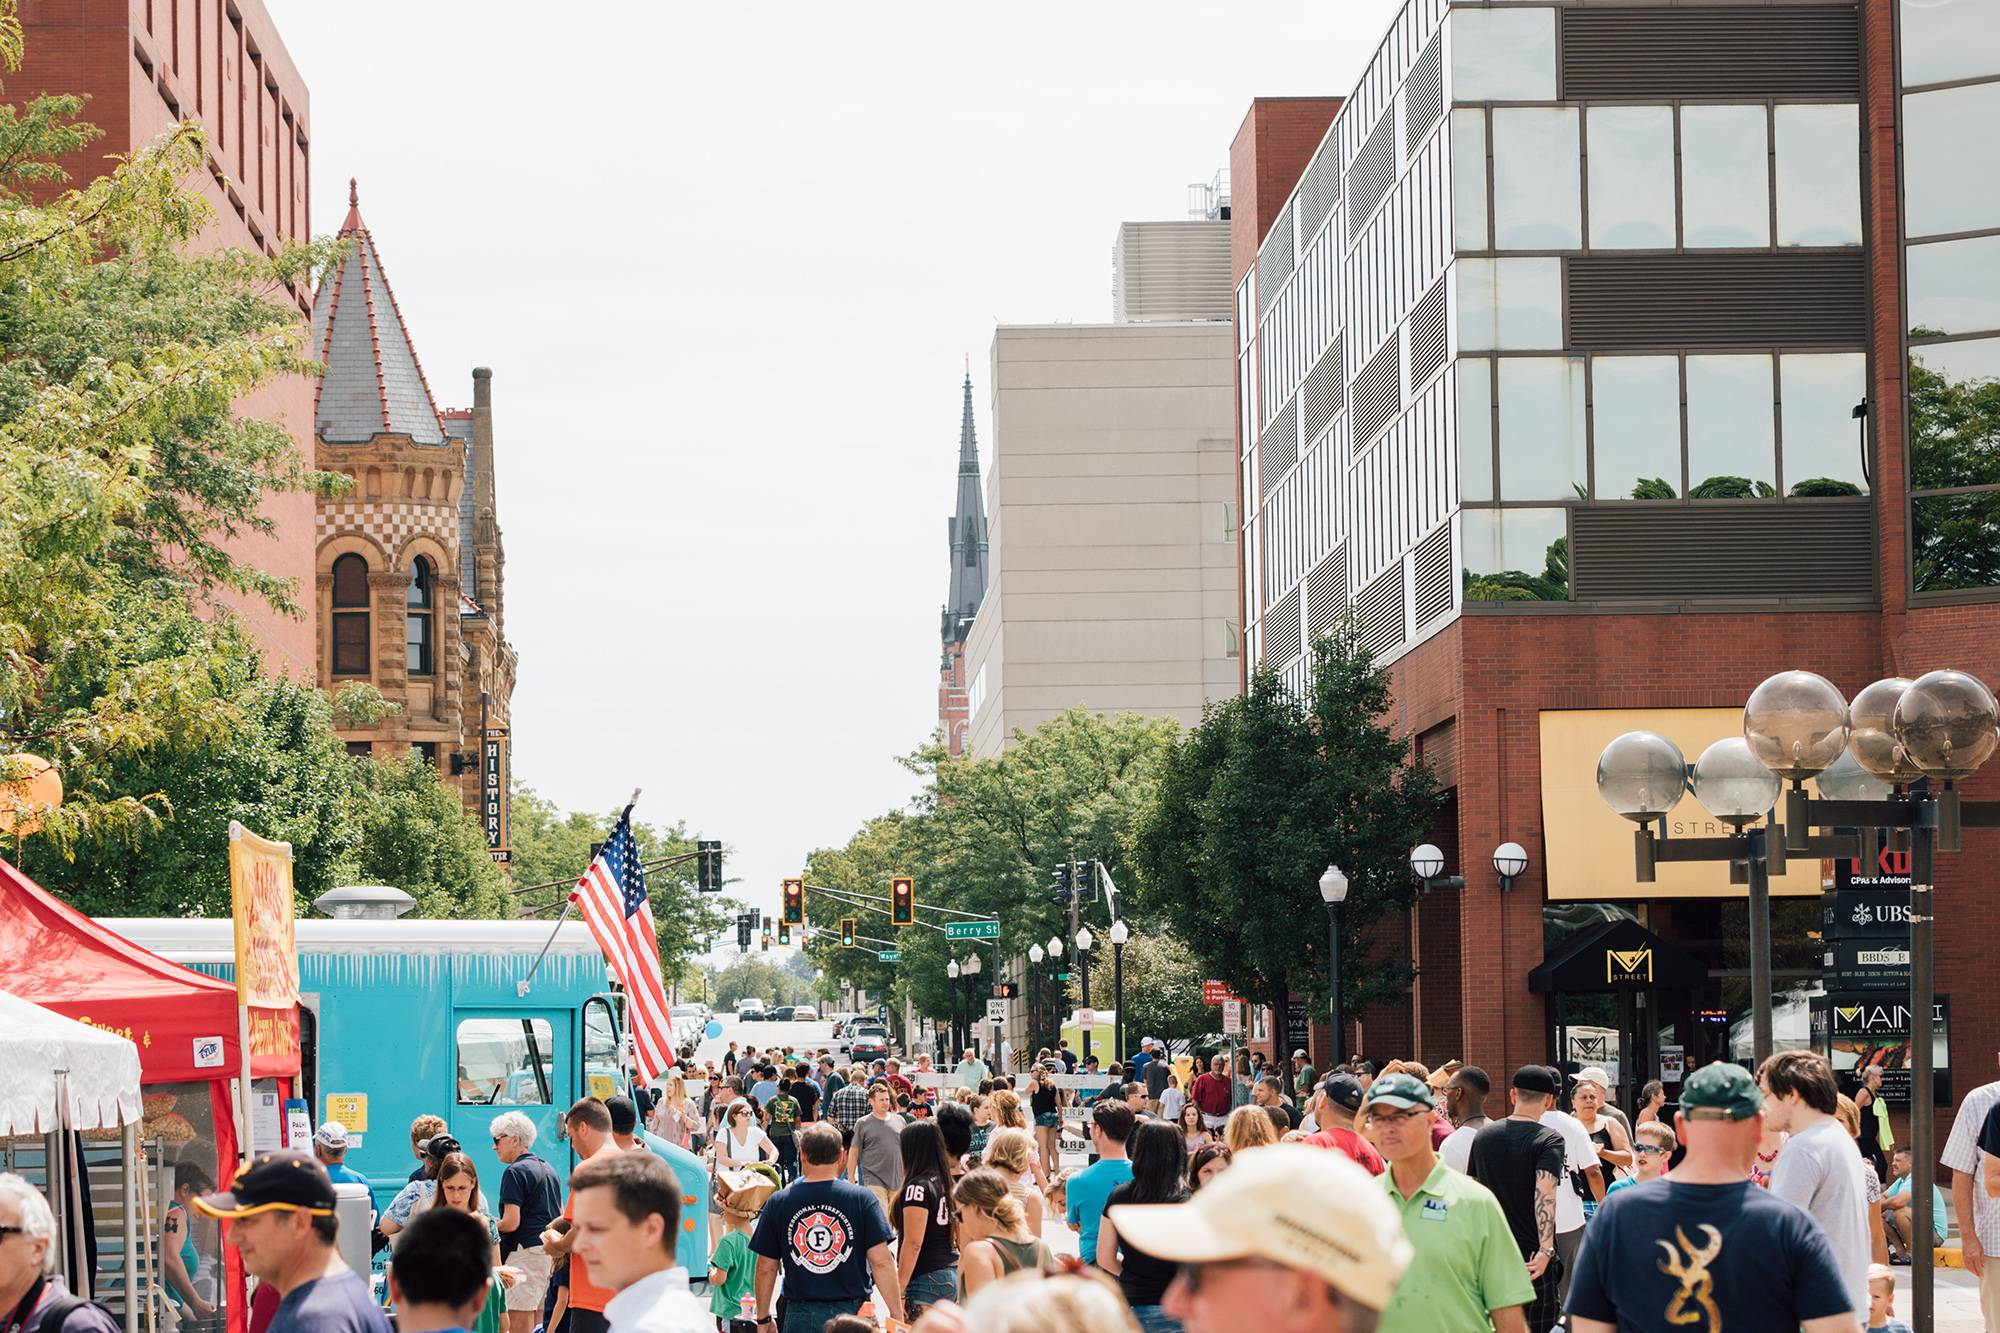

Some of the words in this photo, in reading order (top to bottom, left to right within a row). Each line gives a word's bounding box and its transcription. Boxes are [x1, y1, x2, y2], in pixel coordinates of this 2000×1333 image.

[487, 744, 499, 844] HISTORY
[1674, 821, 1761, 835] STRET
[1851, 845, 1911, 874] KD
[1850, 876, 1870, 885] CPAs
[1876, 905, 1911, 922] UBS
[947, 926, 981, 936] Berry
[986, 925, 998, 934] St
[1607, 949, 1653, 984] M
[1613, 973, 1647, 981] STREET
[1228, 1002, 1236, 1010] NO
[143, 1030, 151, 1048] &
[787, 1204, 817, 1246] PROFESSIONAL
[820, 1204, 854, 1241] FIREFIGHTERS
[813, 1214, 825, 1224] A
[798, 1232, 805, 1246] I
[813, 1230, 826, 1247] F
[833, 1230, 842, 1244] F
[813, 1254, 831, 1262] PAC
